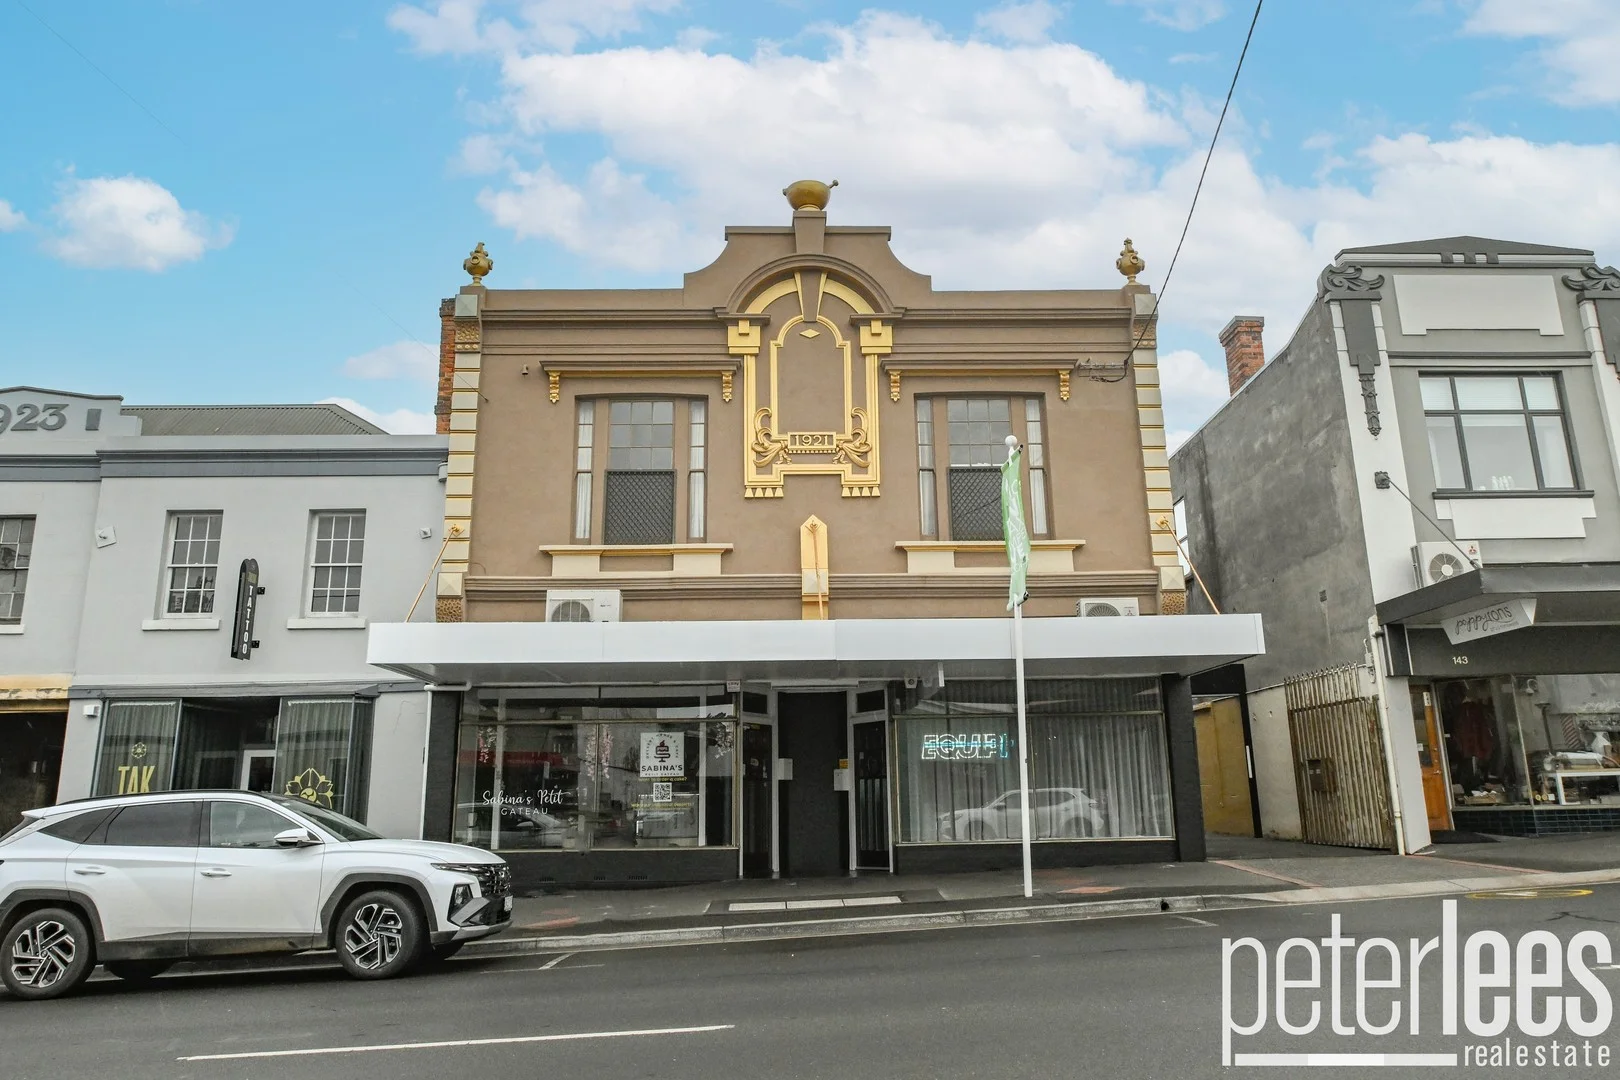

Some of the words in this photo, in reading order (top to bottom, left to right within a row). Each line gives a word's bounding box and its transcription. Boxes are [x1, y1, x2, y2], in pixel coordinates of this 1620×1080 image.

[795, 435, 828, 446] 1921
[242, 585, 254, 655] TATTOO
[1452, 656, 1469, 665] 143
[118, 765, 156, 796] TAK
[482, 790, 533, 806] Sabina's
[537, 785, 571, 805] Petit
[501, 807, 549, 816] GATEAU
